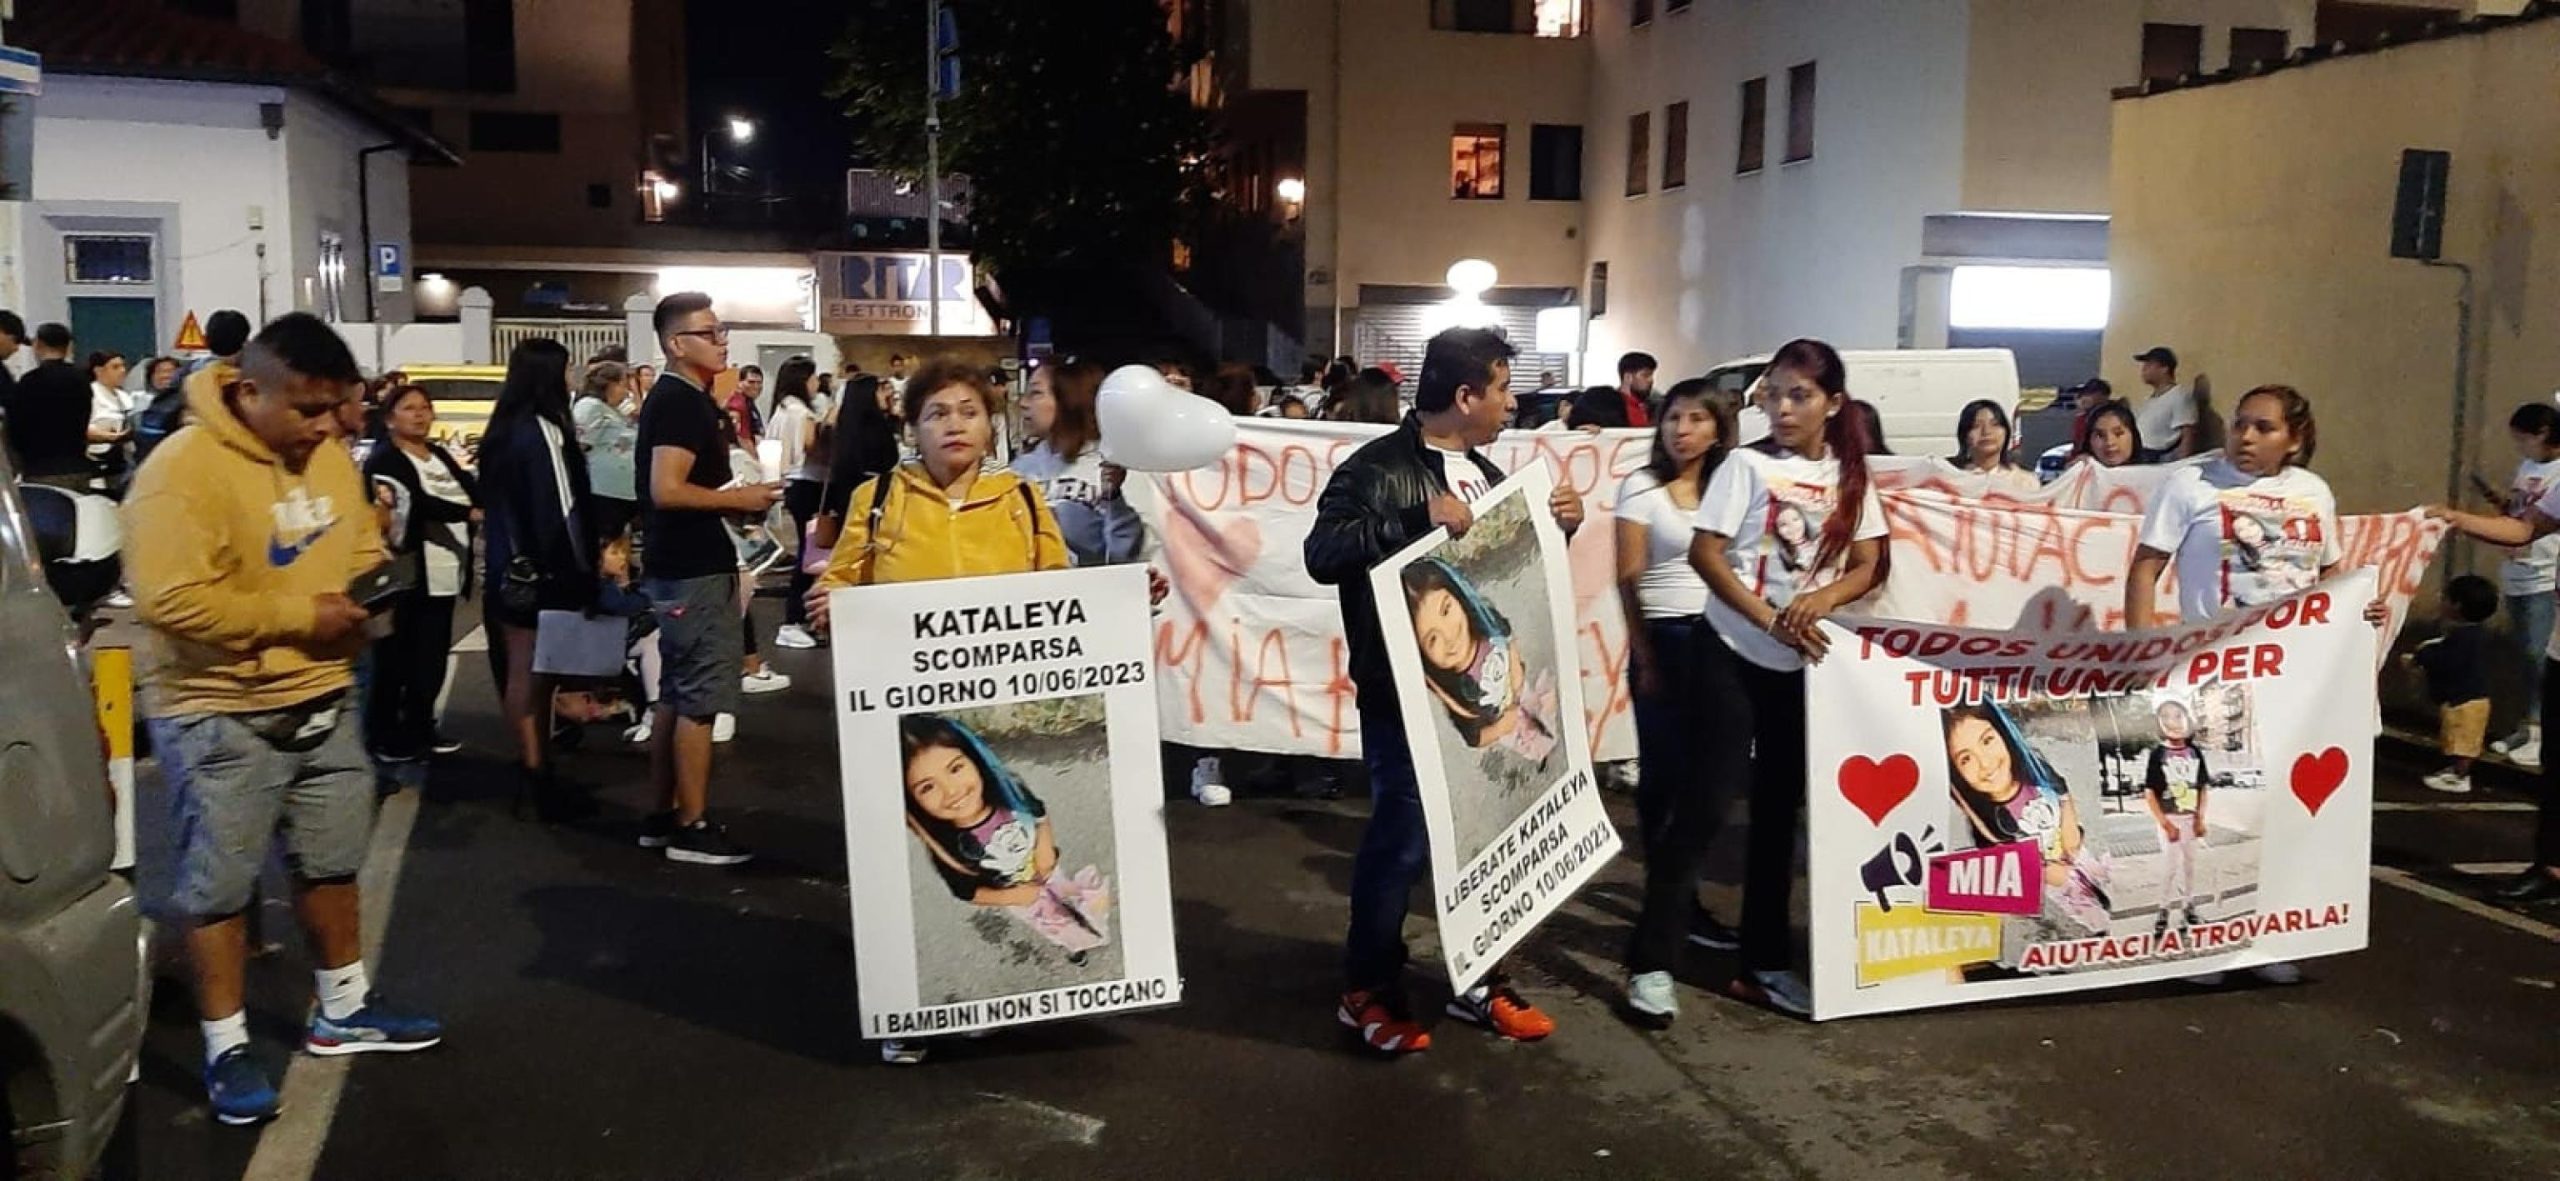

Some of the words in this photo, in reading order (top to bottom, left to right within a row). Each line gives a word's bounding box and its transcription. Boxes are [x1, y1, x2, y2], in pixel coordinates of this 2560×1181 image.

[380, 247, 396, 273] P
[914, 599, 1086, 639] KATALEYA
[1855, 626, 2037, 660] TODOS
[913, 636, 1083, 673] SCOMPARSA
[1905, 664, 2034, 706] TUTTI
[2187, 643, 2284, 686] PER
[850, 689, 875, 712] IL
[886, 678, 997, 708] GIORNO
[1007, 661, 1145, 697] 10/06/2023
[1444, 834, 1517, 914] LIBERATE
[1519, 768, 1588, 845] KATALEYA
[1472, 891, 1534, 957] GIORNO
[1535, 820, 1611, 899] 10/06/2023
[1480, 821, 1569, 914] SCOMPARSA
[1946, 851, 2023, 898] MIA
[1864, 920, 1995, 964] KATALEYA
[2021, 934, 2150, 971] AIUTACI
[2156, 927, 2185, 953] A
[2191, 902, 2350, 950] TROVARLA!
[873, 1014, 880, 1034] I
[888, 1005, 980, 1033] BAMBINI
[987, 997, 1033, 1024] NON
[1039, 992, 1060, 1015] SI
[1066, 978, 1167, 1011] TOCCANO
